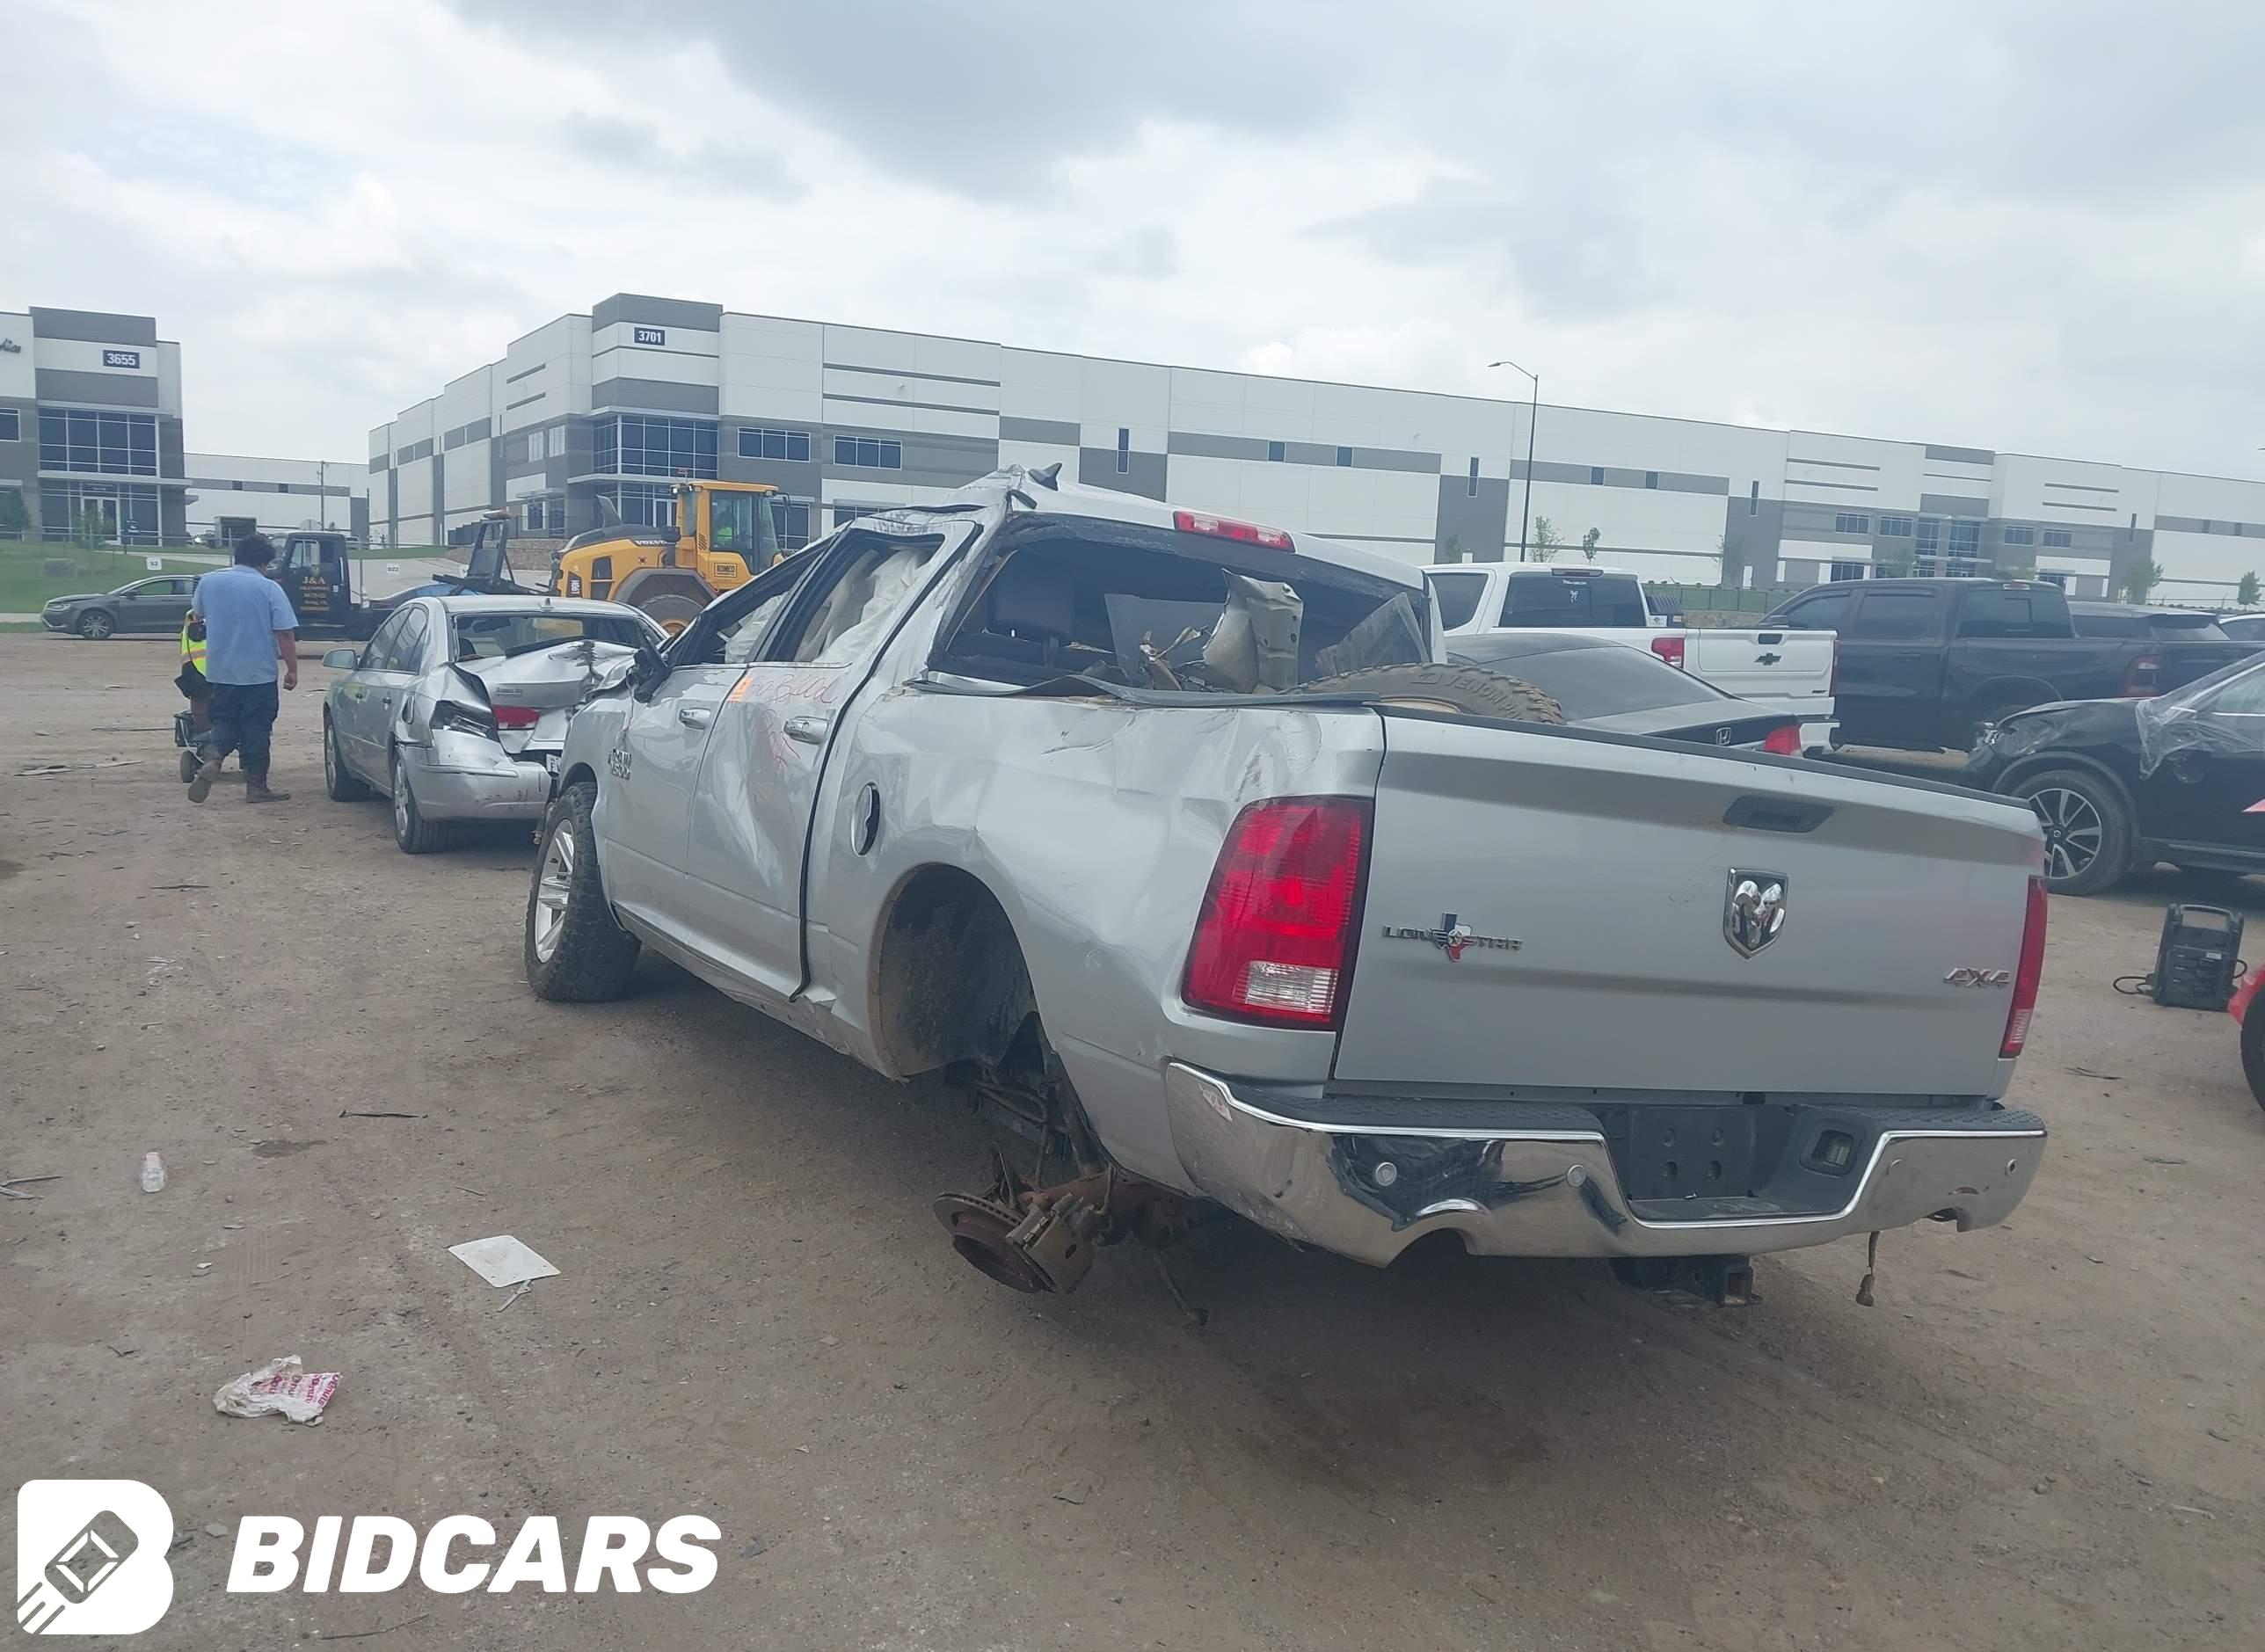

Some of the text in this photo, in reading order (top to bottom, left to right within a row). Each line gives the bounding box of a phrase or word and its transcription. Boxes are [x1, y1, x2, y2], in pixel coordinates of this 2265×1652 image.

[637, 330, 661, 343] 3701
[106, 353, 135, 366] 3655
[717, 564, 735, 573] ROMCO
[302, 576, 325, 585] J&A
[1381, 925, 1524, 951] LONE STAR
